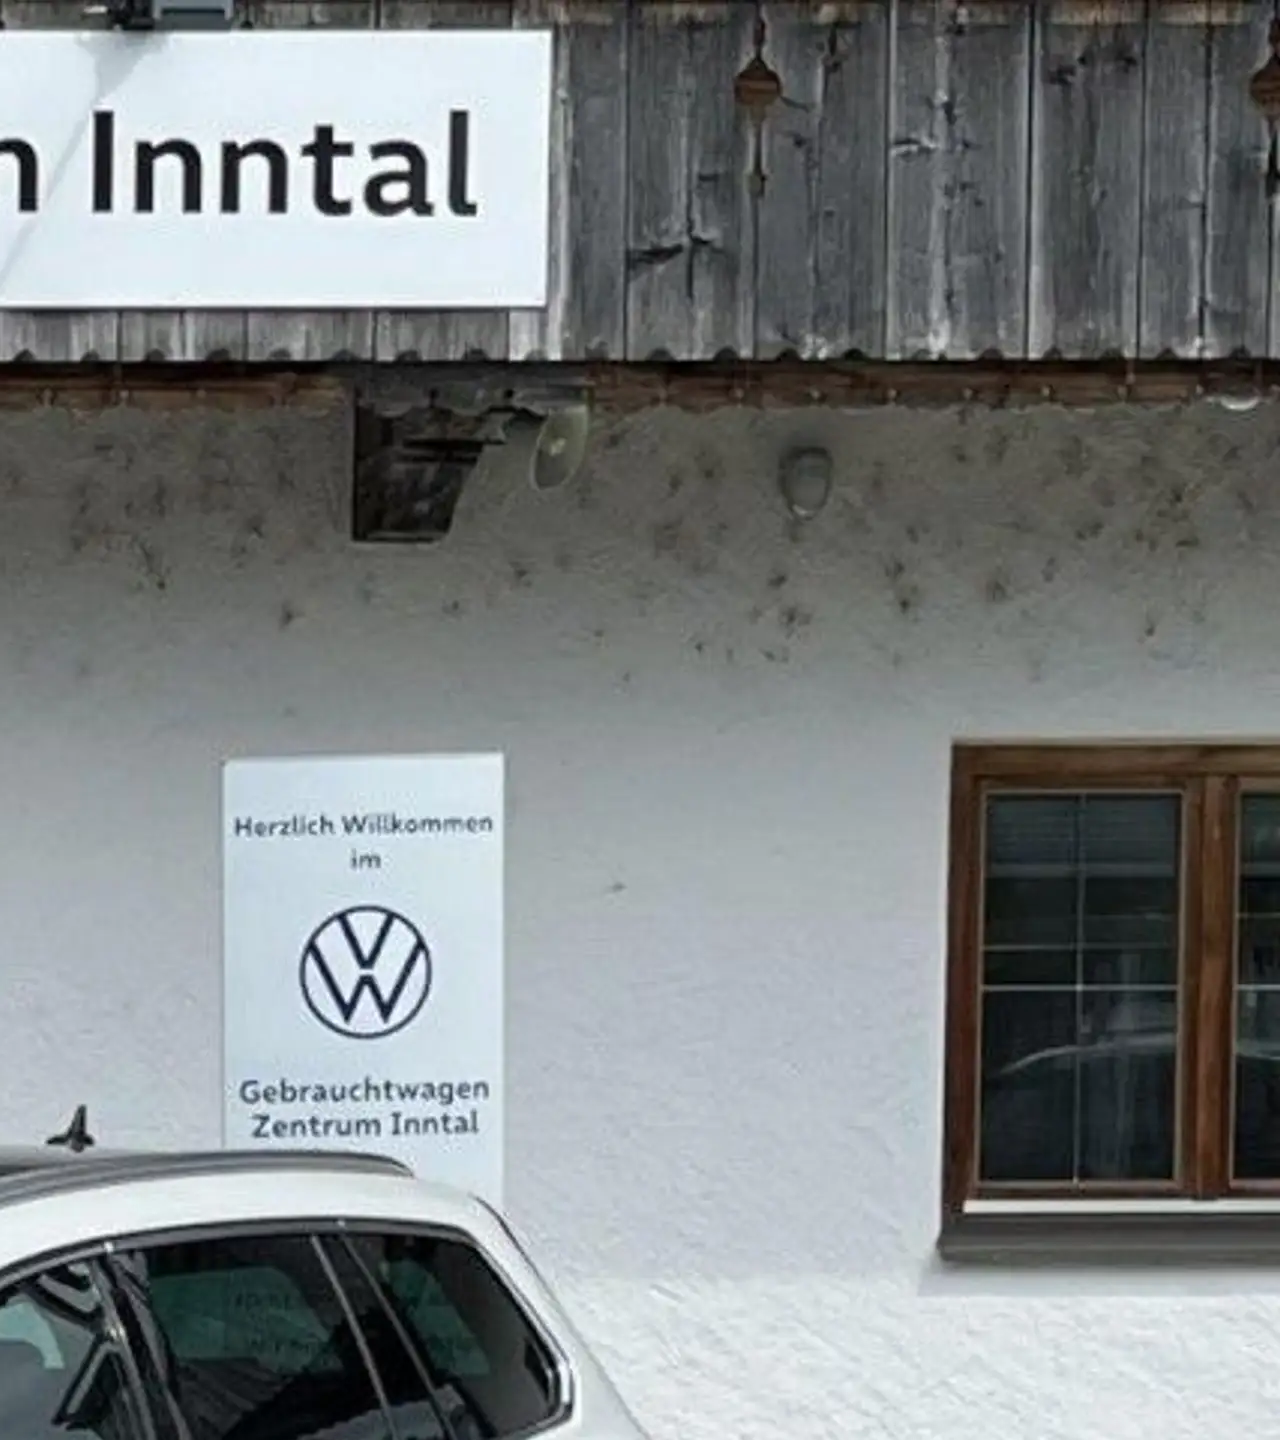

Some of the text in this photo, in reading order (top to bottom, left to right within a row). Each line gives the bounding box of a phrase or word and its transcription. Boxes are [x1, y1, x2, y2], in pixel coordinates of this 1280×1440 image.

[91, 109, 479, 217] Inntal
[234, 812, 493, 837] Herzlich Willkommen
[350, 849, 383, 869] im
[298, 904, 433, 1041] VW
[239, 1076, 490, 1106] Gebrauchtwagen
[251, 1109, 479, 1139] Zentrum Inntal
